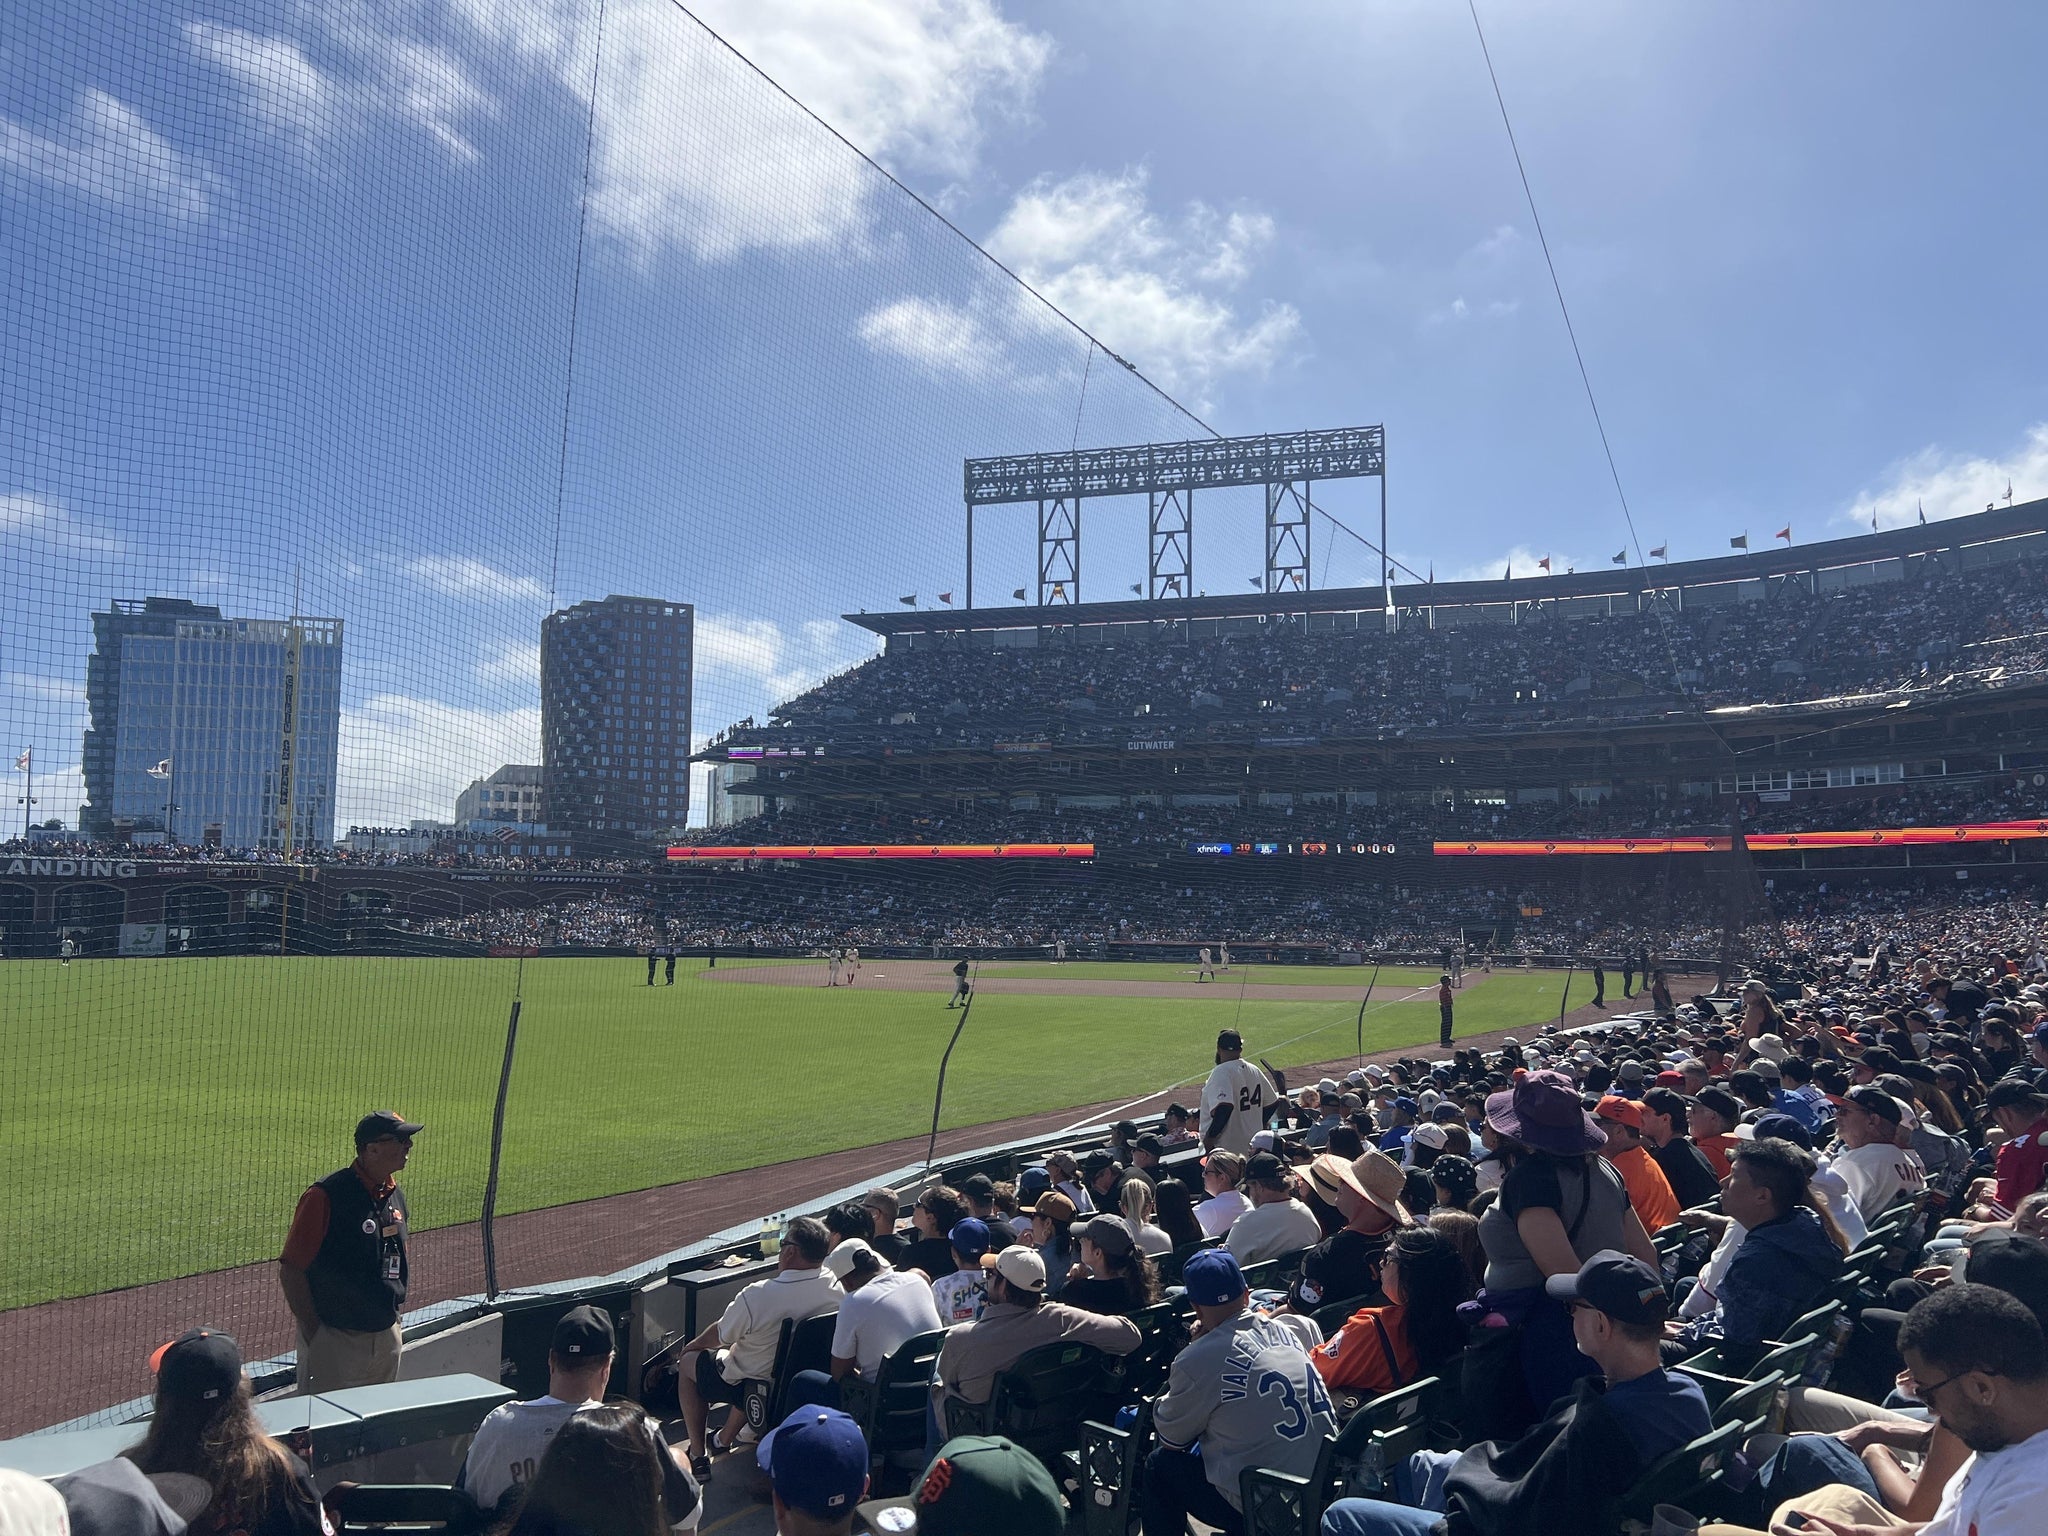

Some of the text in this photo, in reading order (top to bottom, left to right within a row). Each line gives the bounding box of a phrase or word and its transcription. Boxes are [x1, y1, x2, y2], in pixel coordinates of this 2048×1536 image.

[1128, 741, 1174, 750] CUTWATER
[350, 826, 488, 841] BANK OF AMERICA
[1196, 845, 1222, 854] xfinity
[1287, 844, 1293, 854] 1
[1336, 844, 1342, 854] 1
[0, 860, 137, 878] ANDING
[1240, 1084, 1262, 1112] 24
[1257, 1362, 1340, 1441] 34
